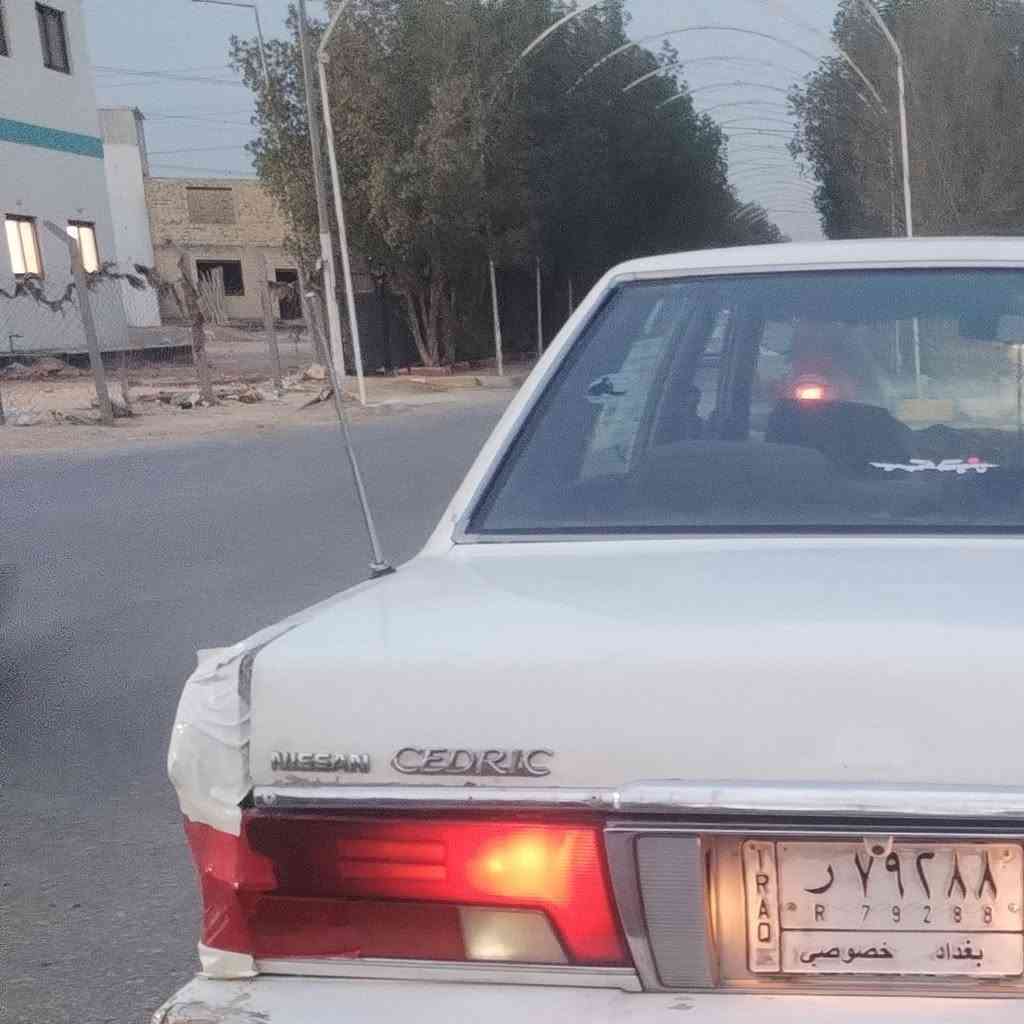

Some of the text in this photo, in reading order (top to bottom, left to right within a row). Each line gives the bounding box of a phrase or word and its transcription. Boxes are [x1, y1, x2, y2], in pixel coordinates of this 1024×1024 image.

[271, 747, 554, 778] NISSAN CEDRIC
[756, 848, 771, 944] IRAQ
[814, 905, 993, 924] R 79288
[799, 939, 984, 968] بغداد خصوصي
